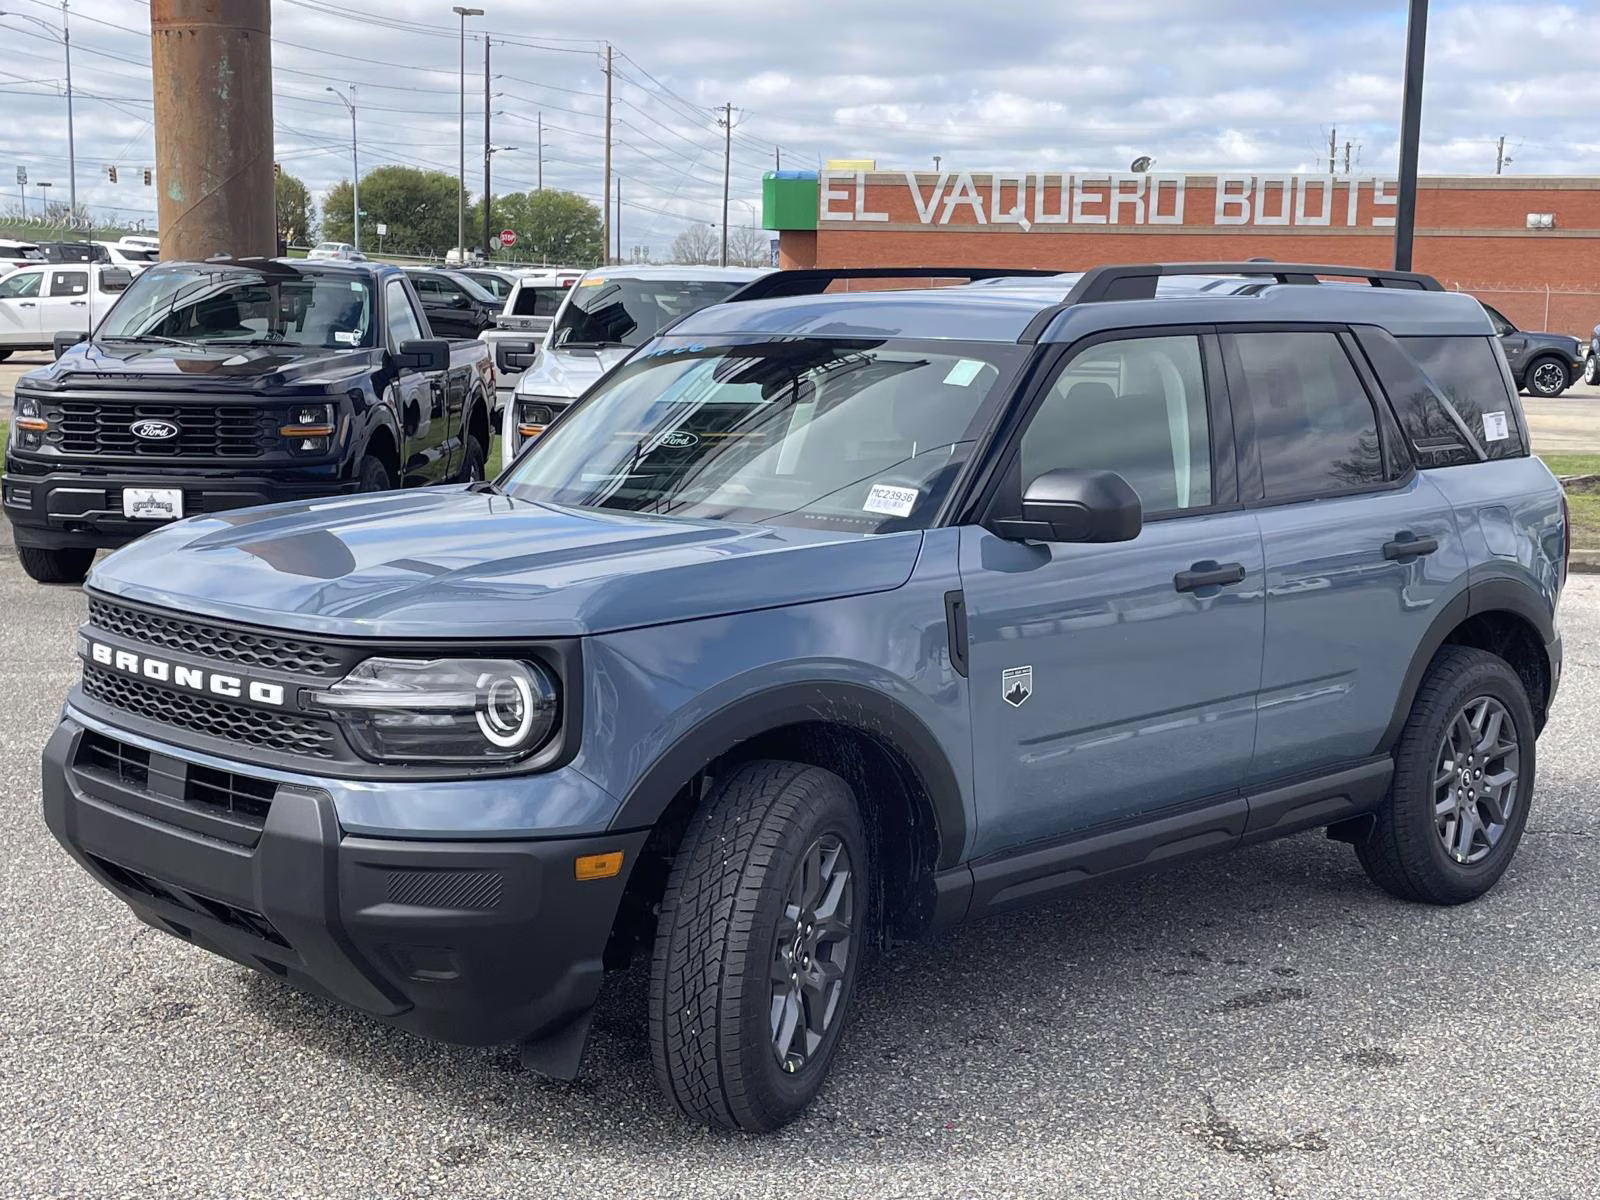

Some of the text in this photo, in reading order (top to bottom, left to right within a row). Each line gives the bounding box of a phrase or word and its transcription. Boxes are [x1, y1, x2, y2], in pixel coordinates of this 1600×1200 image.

[820, 171, 1399, 233] EL VAQUERO BOOTS
[140, 424, 169, 437] Ford
[872, 488, 914, 503] MC23936
[92, 642, 284, 706] BRONCO
